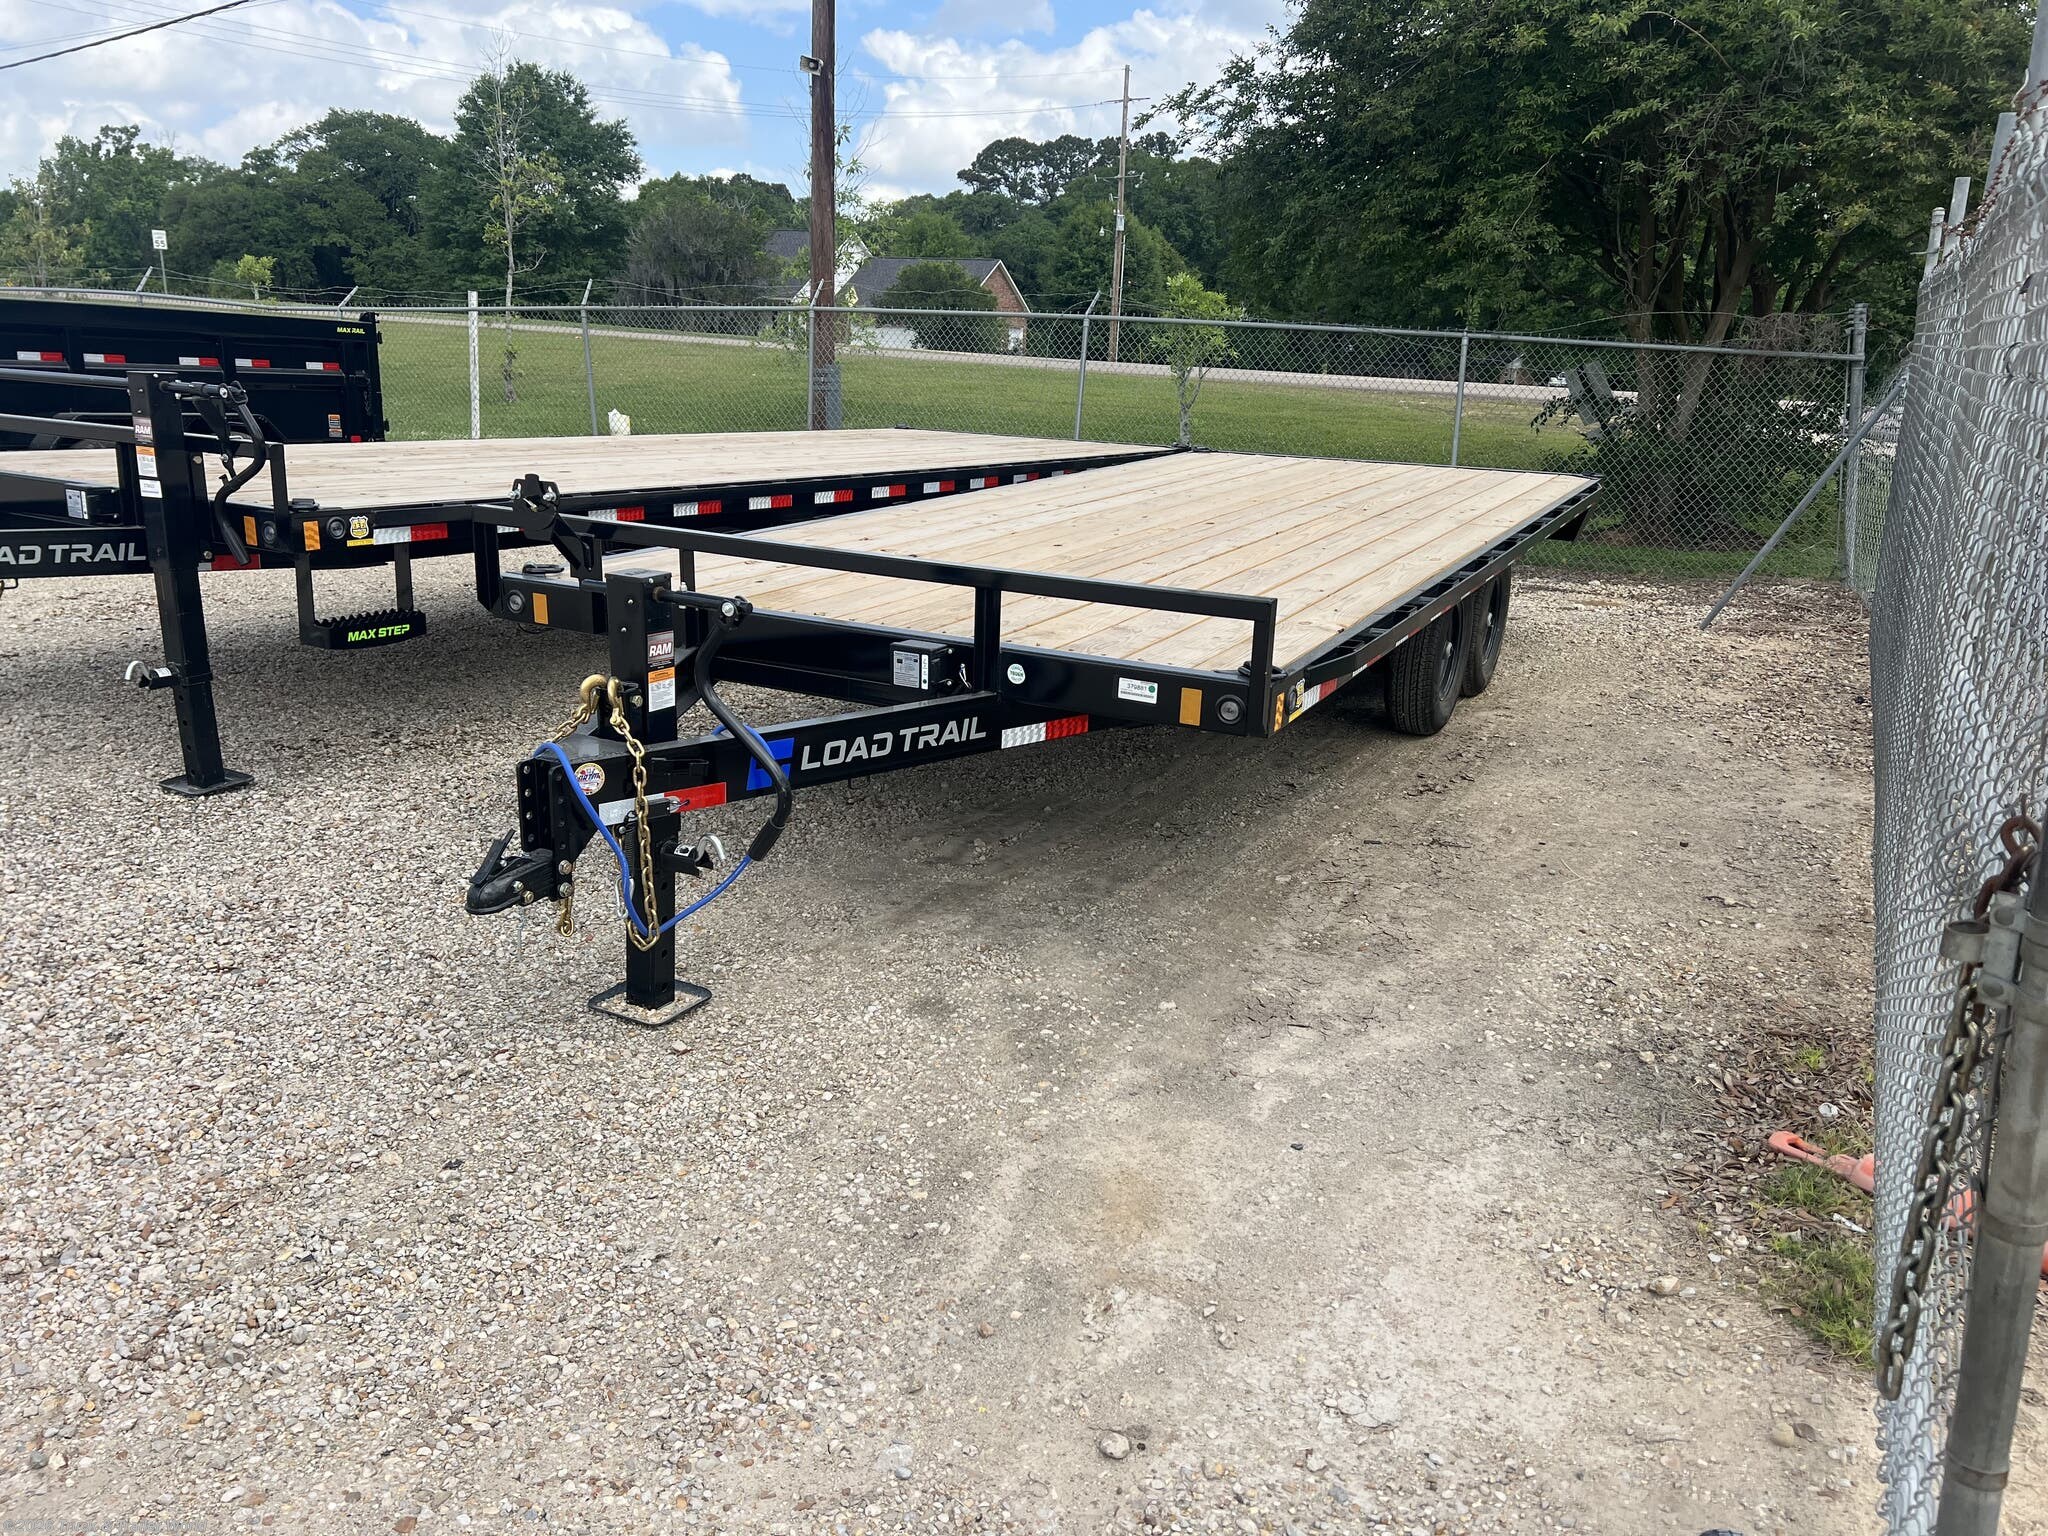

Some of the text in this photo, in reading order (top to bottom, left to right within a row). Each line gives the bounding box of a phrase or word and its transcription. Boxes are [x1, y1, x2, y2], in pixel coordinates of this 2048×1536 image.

[154, 239, 166, 248] 55
[336, 326, 366, 335] MAX RAIL
[135, 424, 152, 435] RAM
[48, 543, 147, 564] TRAIL
[347, 624, 410, 642] MAX STEP
[649, 642, 672, 657] RAM
[800, 716, 987, 771] LOAD TRAIL
